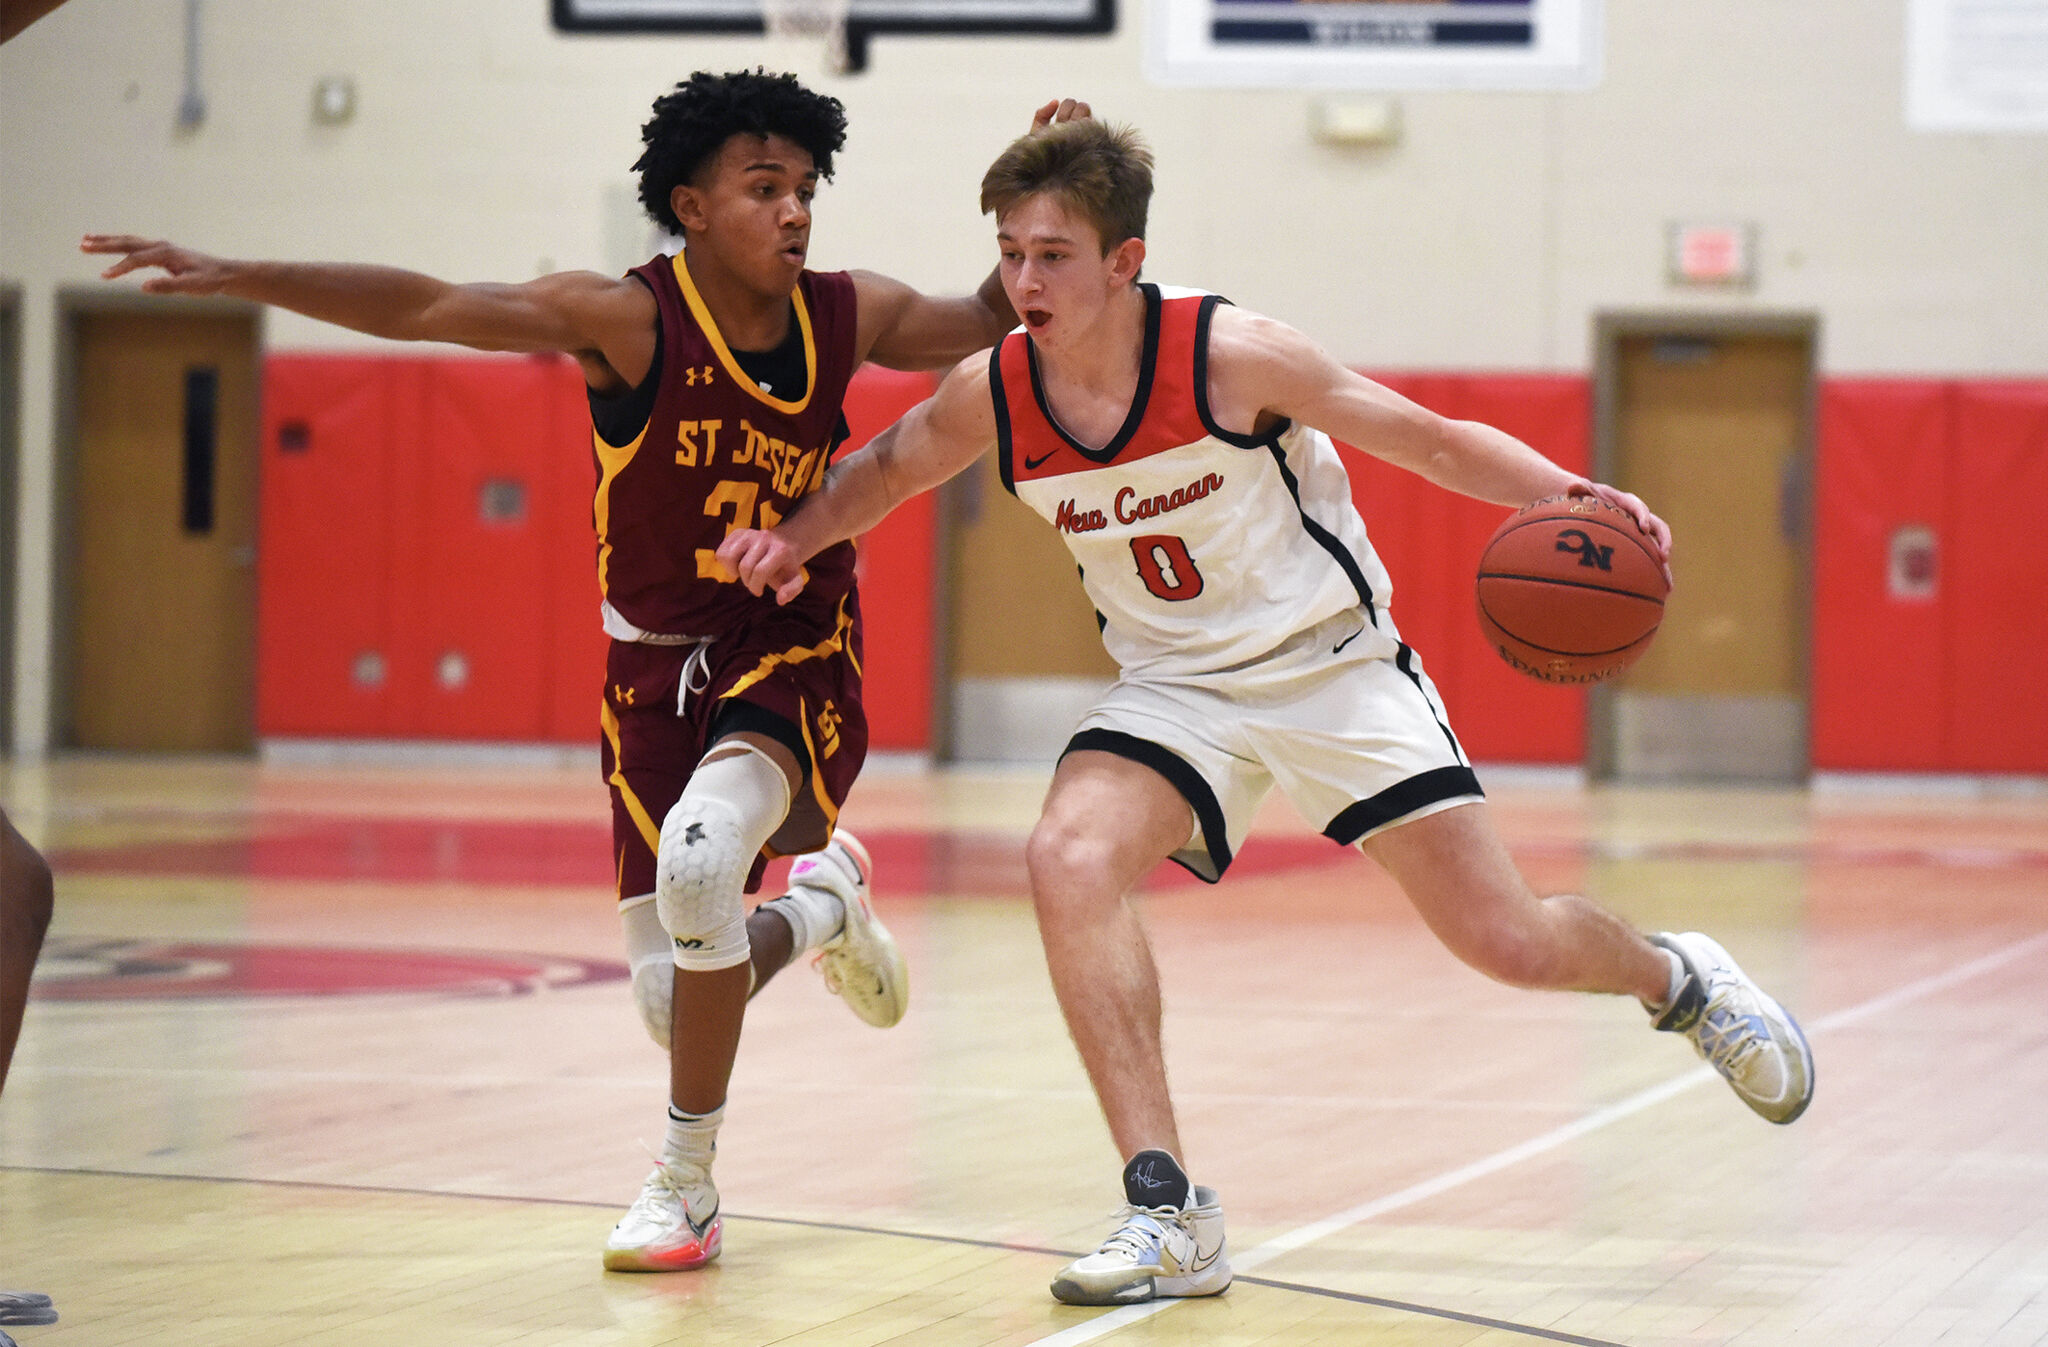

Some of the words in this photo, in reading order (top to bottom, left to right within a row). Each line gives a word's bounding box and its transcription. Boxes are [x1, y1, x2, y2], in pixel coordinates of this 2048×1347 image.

[675, 419, 723, 468] ST
[1055, 498, 1108, 534] New
[1114, 472, 1225, 525] Canaan
[1129, 534, 1205, 602] 0
